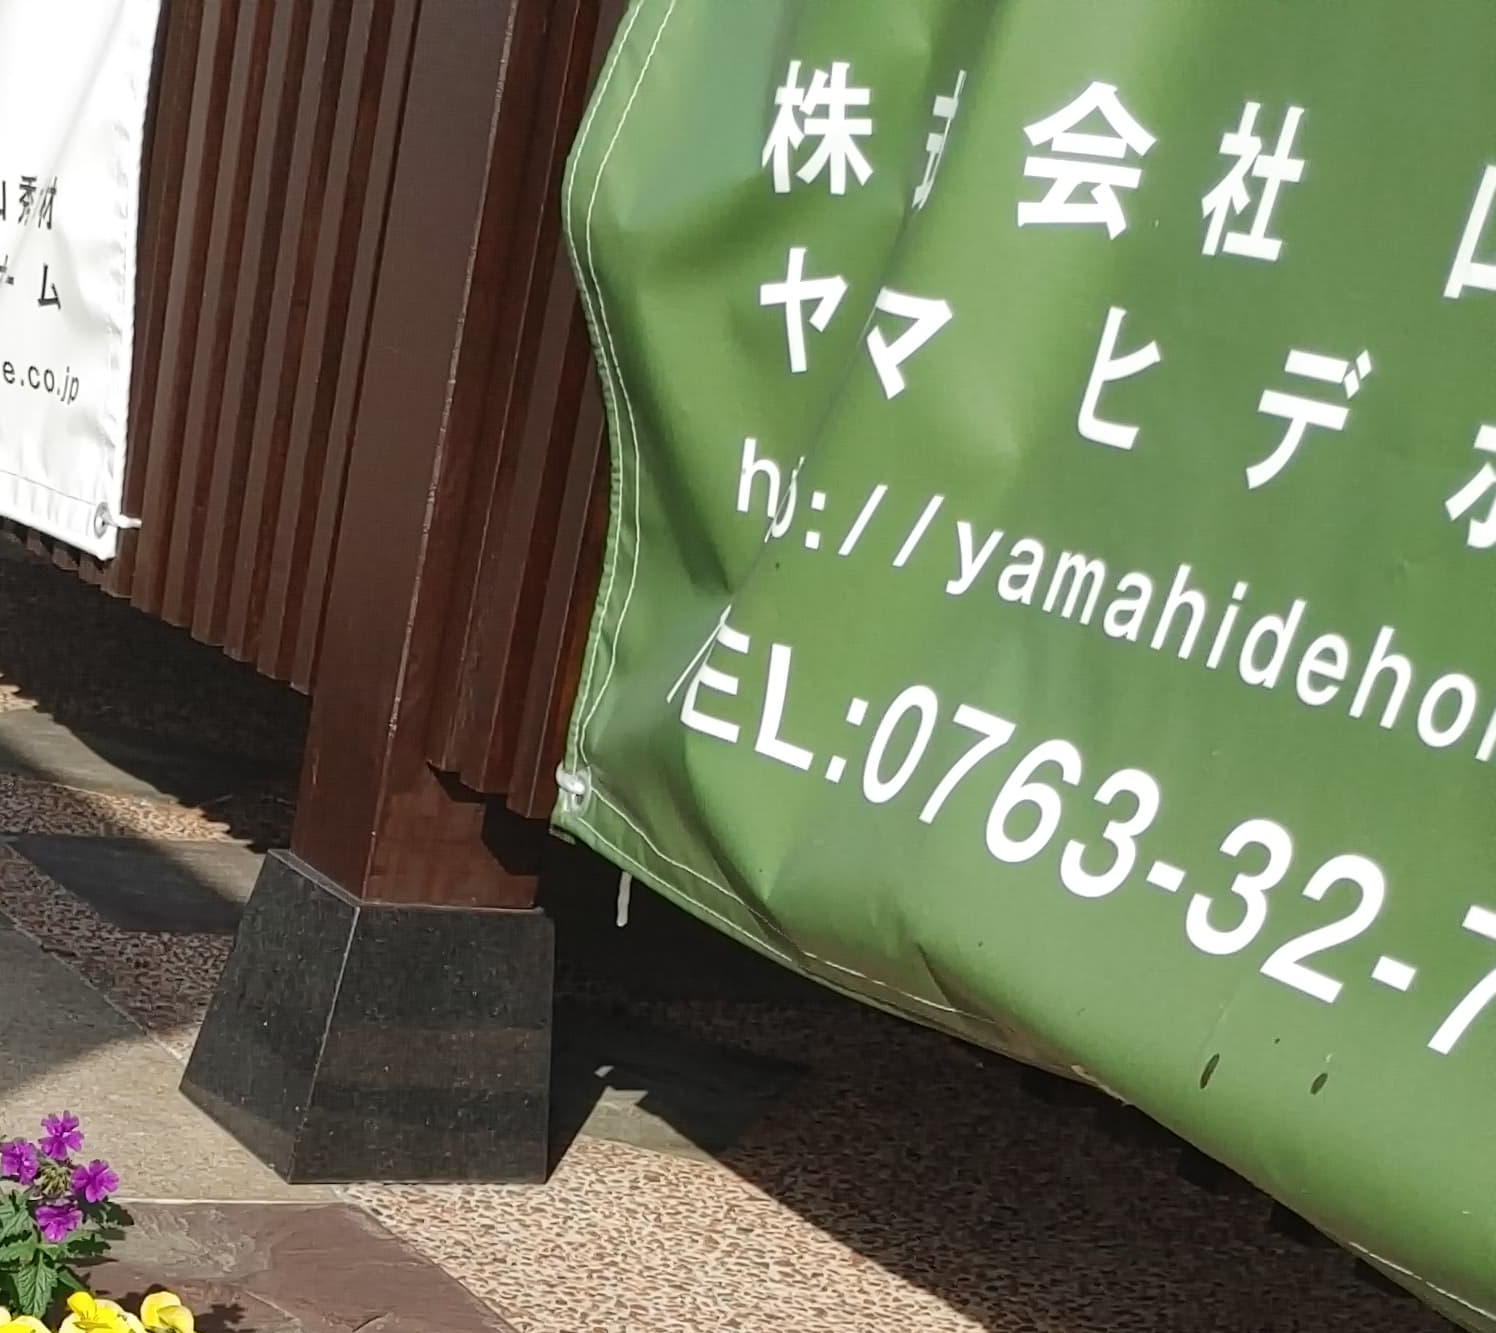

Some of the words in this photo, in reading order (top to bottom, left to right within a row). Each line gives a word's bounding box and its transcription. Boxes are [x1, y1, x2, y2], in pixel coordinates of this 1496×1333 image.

[761, 60, 1307, 263] 株会社
[667, 604, 1496, 1055] EL:0763-32-7
